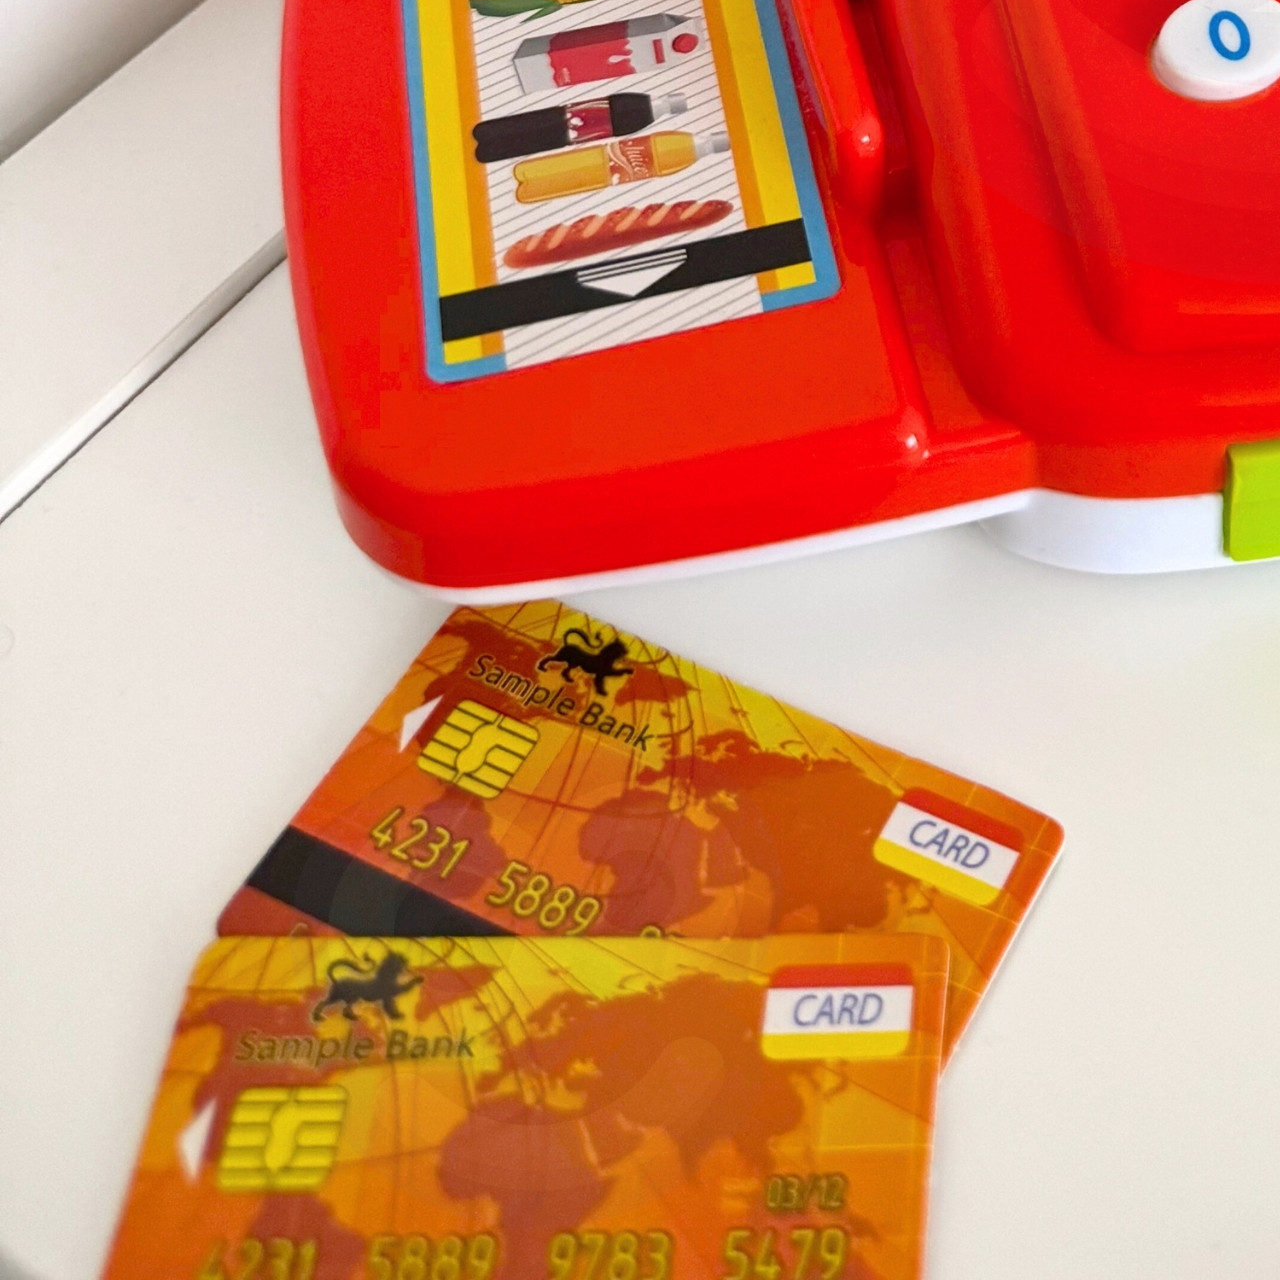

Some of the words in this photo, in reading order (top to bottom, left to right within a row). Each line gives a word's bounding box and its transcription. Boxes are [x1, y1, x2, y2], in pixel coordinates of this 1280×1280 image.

[1208, 10, 1252, 61] 0
[466, 653, 577, 718] Sample
[580, 699, 658, 753] Bank
[907, 818, 992, 872] CARD
[370, 807, 470, 879] 4231
[486, 860, 602, 936] 5889
[791, 991, 885, 1029] CARD
[235, 1030, 375, 1066] Sample
[387, 1027, 477, 1059] Bank
[765, 1175, 845, 1210] 03/12
[550, 1230, 671, 1280] 9783
[723, 1228, 846, 1280] 5479
